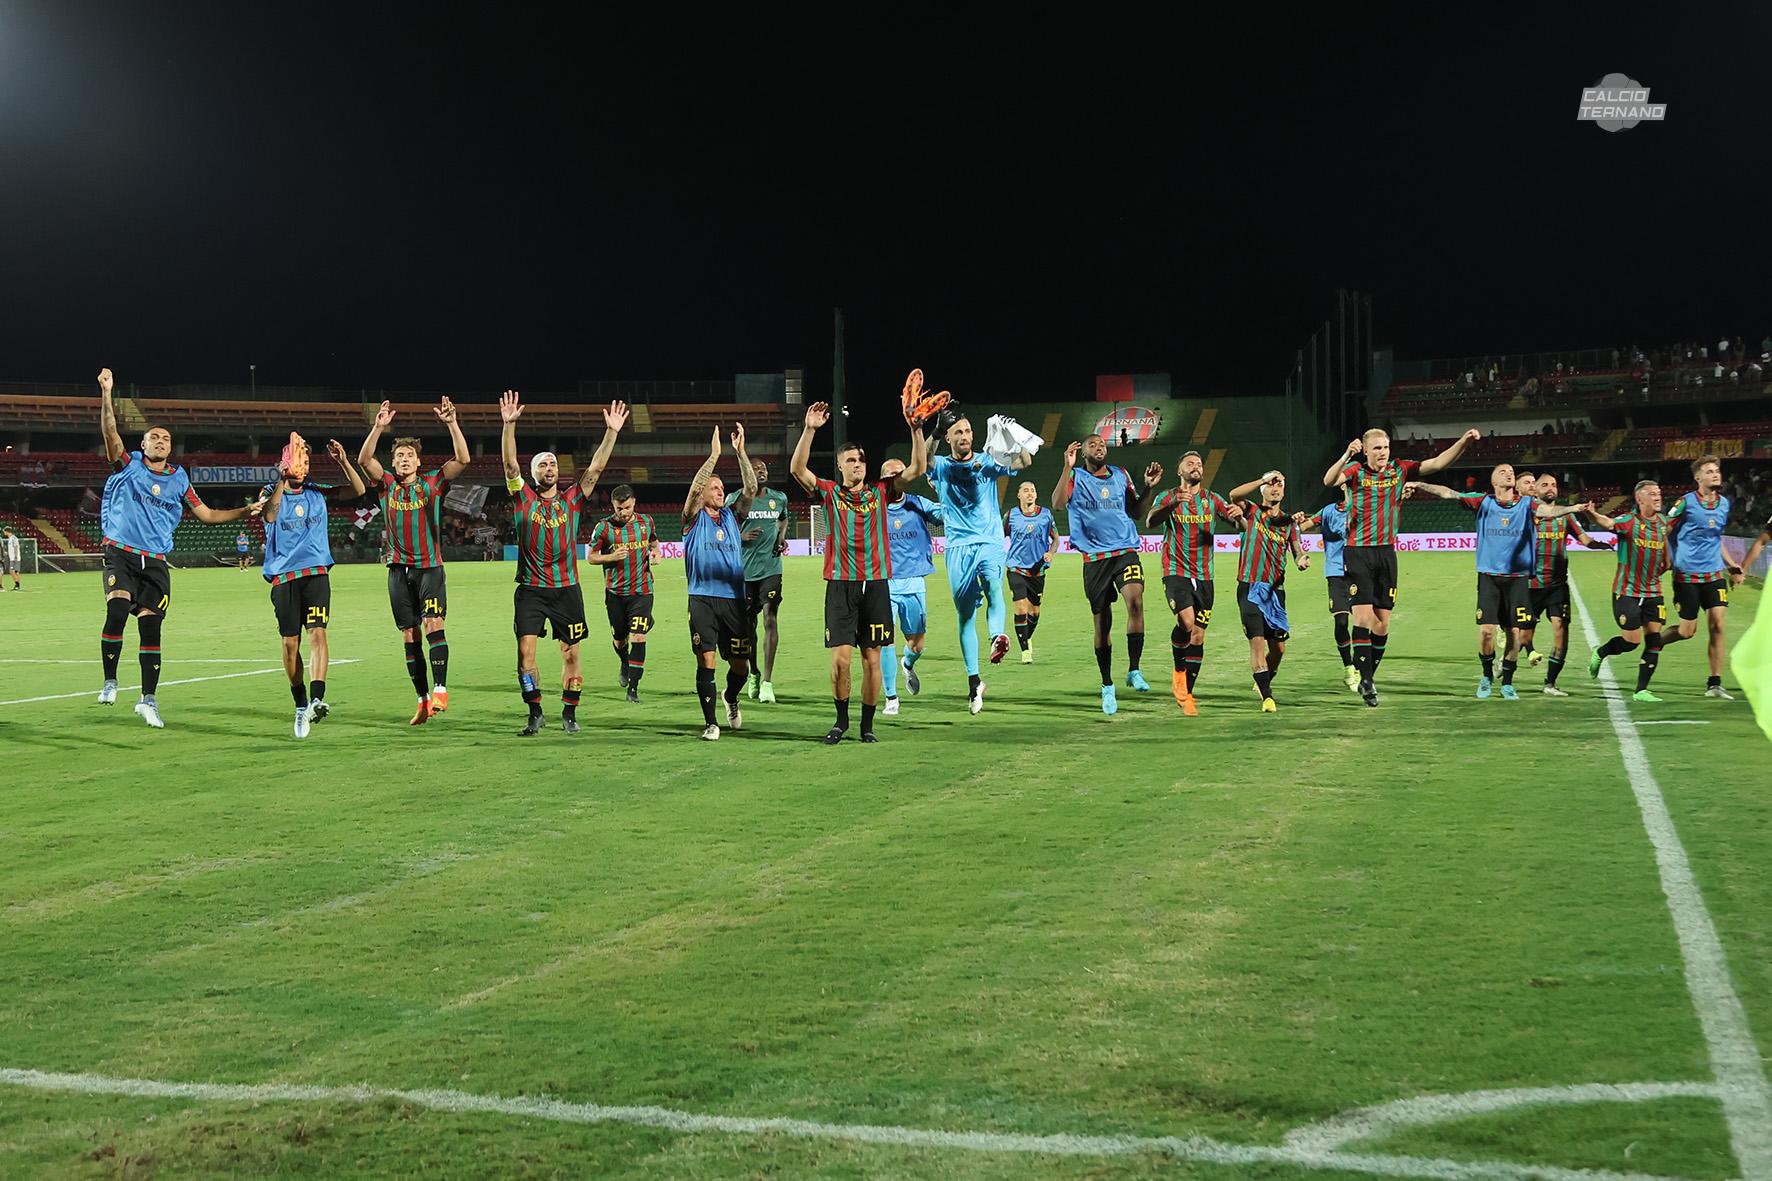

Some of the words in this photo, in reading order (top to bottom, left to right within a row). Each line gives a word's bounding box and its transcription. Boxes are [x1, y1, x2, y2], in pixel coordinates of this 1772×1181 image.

[191, 468, 280, 482] MONTEBELLO
[1123, 565, 1141, 581] 23
[1389, 587, 1397, 603] 4
[307, 606, 328, 623] 24
[1516, 607, 1527, 622] 5
[631, 616, 648, 631] 34
[870, 624, 885, 642] 17
